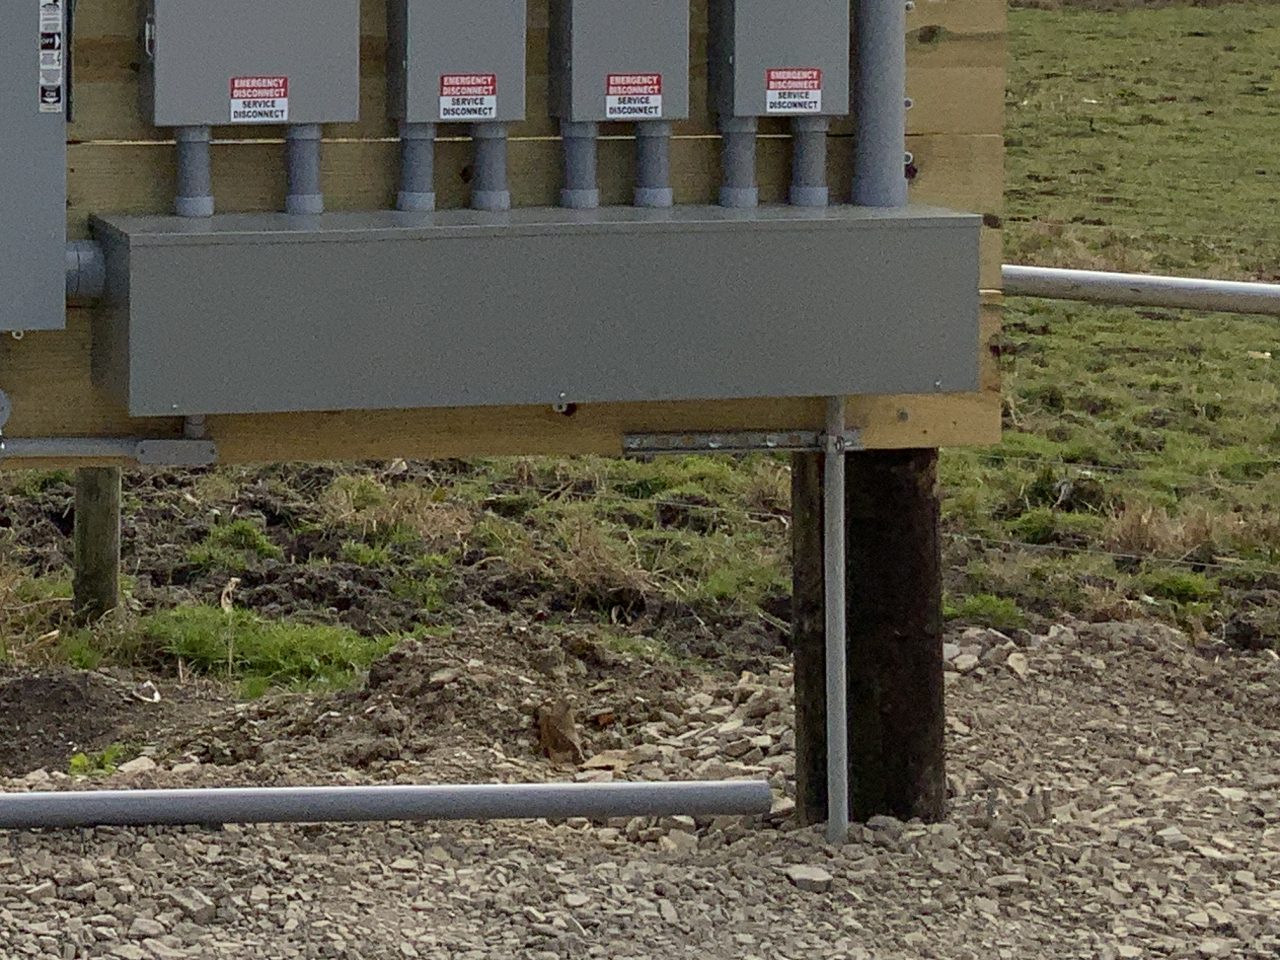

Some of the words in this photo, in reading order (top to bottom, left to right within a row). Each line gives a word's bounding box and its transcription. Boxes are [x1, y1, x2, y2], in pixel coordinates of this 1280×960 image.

[770, 70, 818, 79] EMERGENCY
[234, 79, 285, 88] EMERGENCY
[443, 76, 493, 86] EMERGENCY
[609, 76, 659, 85] EMERGENCY
[769, 80, 818, 89] DISCONNECT
[233, 89, 285, 98] DISCONNECT
[442, 86, 493, 95] DISCONNECT
[609, 85, 659, 95] DISCONNECT
[778, 91, 809, 100] SERVICE
[242, 100, 276, 108] SERVICE
[451, 97, 484, 106] SERVICE
[617, 96, 650, 105] SERVICE
[769, 101, 818, 109] DISCONNECT
[233, 110, 285, 119] DISCONNECT
[442, 107, 493, 116] DISCONNECT
[609, 106, 659, 115] DISCONNECT
